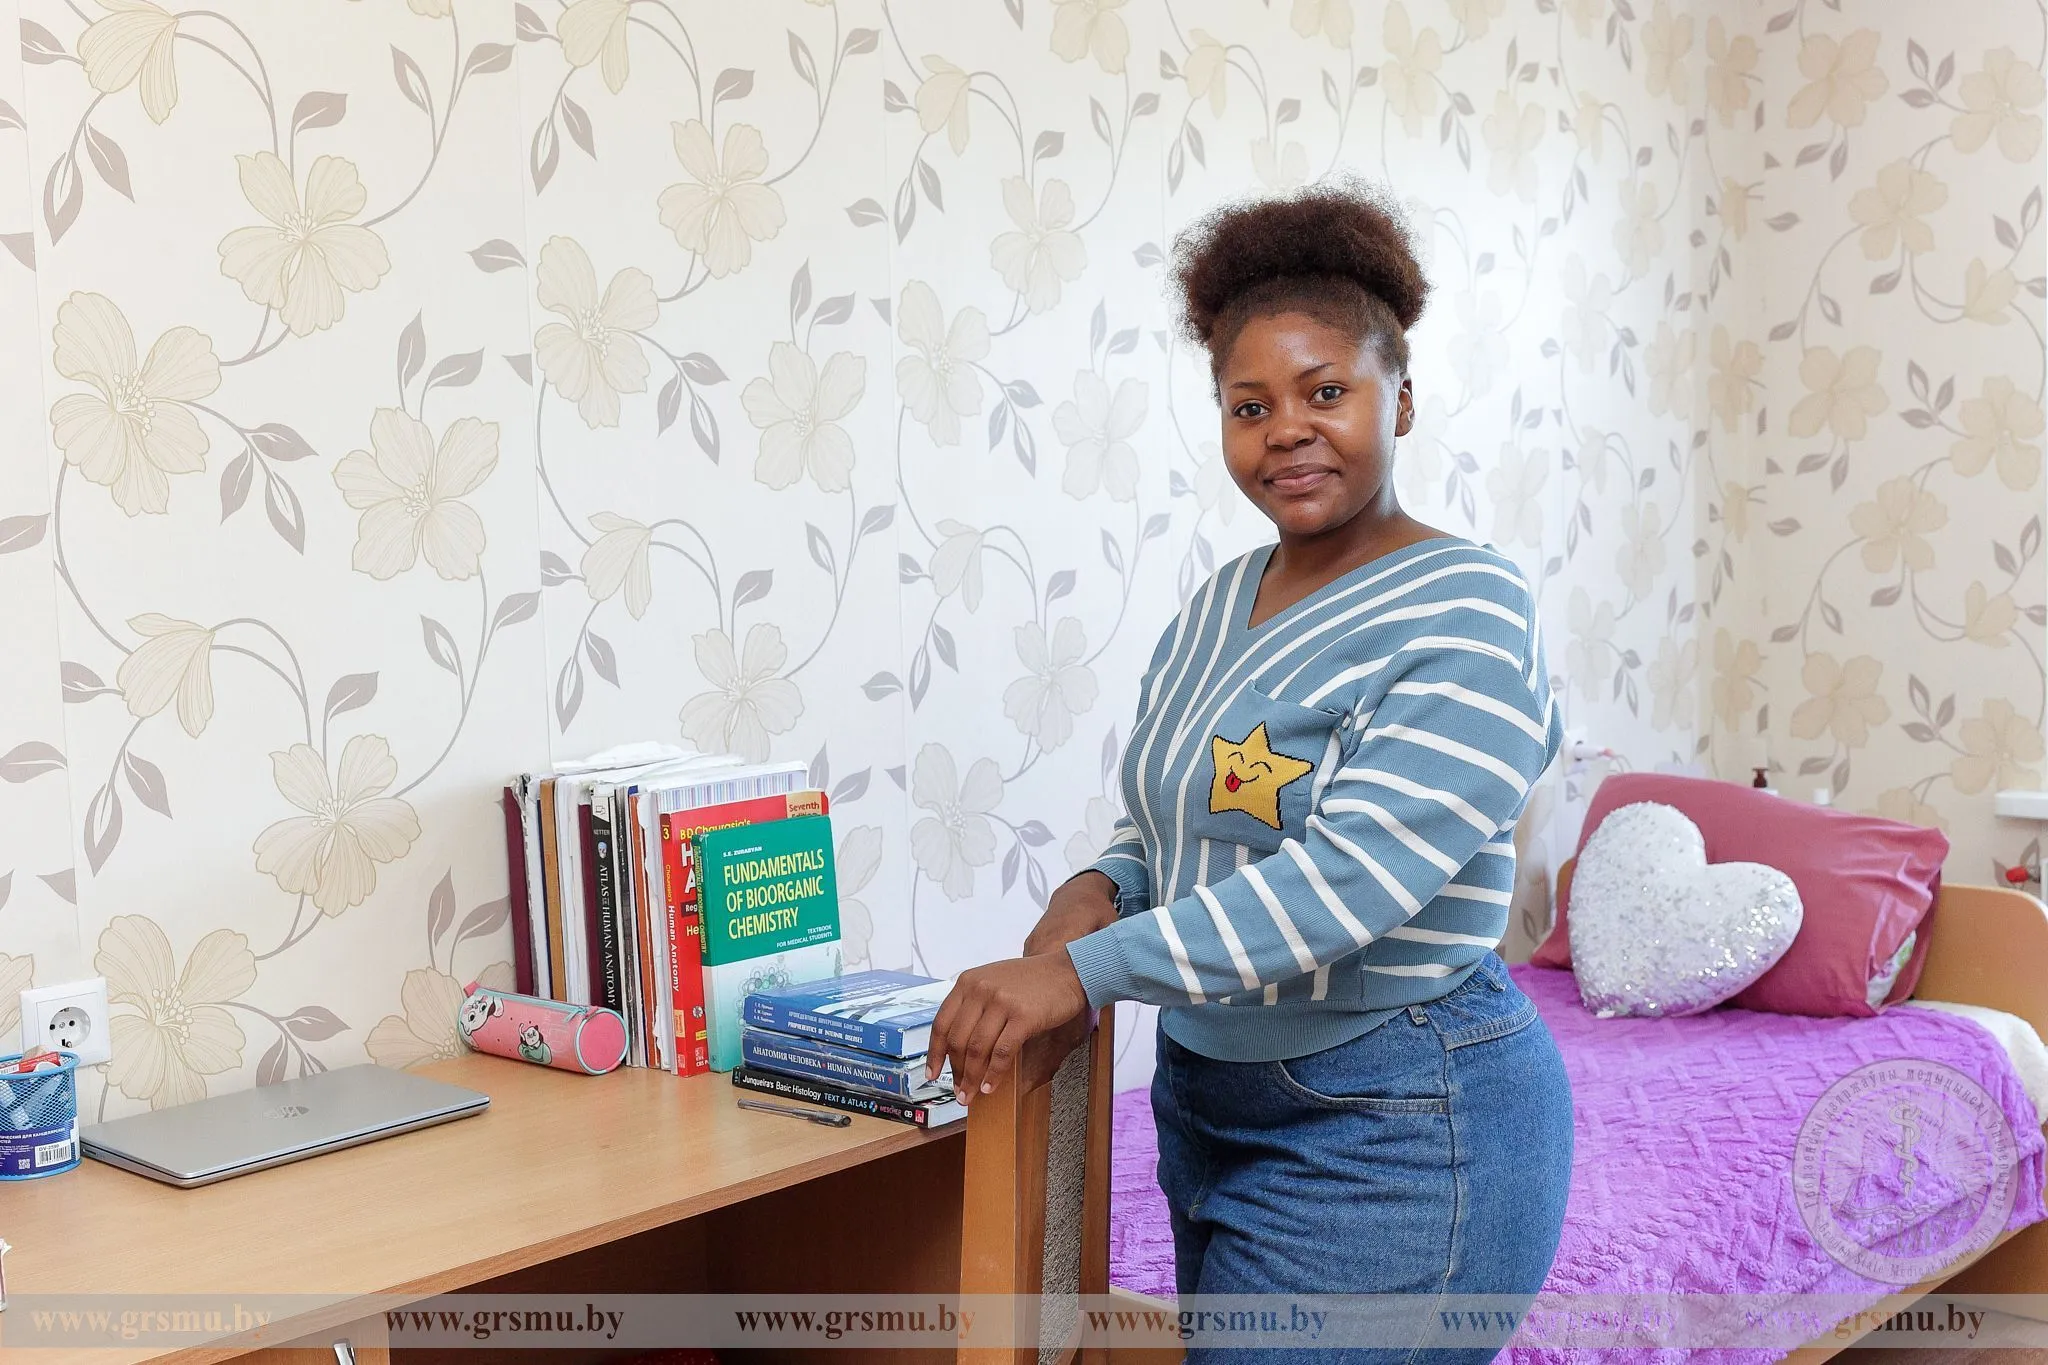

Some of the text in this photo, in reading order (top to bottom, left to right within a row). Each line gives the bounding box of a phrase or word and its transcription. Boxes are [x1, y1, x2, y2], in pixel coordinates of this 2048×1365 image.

[789, 801, 820, 812] Seventh
[663, 827, 670, 840] 3
[600, 865, 609, 897] ATLAS
[723, 848, 825, 886] FUNDAMENTALS
[726, 875, 825, 913] OF BIOORGANIC
[603, 907, 612, 949] HUMAN
[668, 905, 676, 942] Human
[728, 906, 799, 940] CHEMISTRY
[776, 931, 833, 948] FOR MEDICAL STUDENTS
[807, 924, 832, 934] TEXTBOOK
[605, 951, 616, 1006] ANATOMY
[670, 944, 679, 992] Anatomy
[753, 1046, 822, 1069] АНАТОМИЯ ЧЕЛОВЕКА
[827, 1062, 886, 1082] HUMAN ANATOMY
[742, 1075, 774, 1088] Junqueira's
[775, 1080, 792, 1093] Basic
[792, 1083, 822, 1101] Histology
[824, 1092, 840, 1102] TEXT
[847, 1098, 868, 1109] ATLAS
